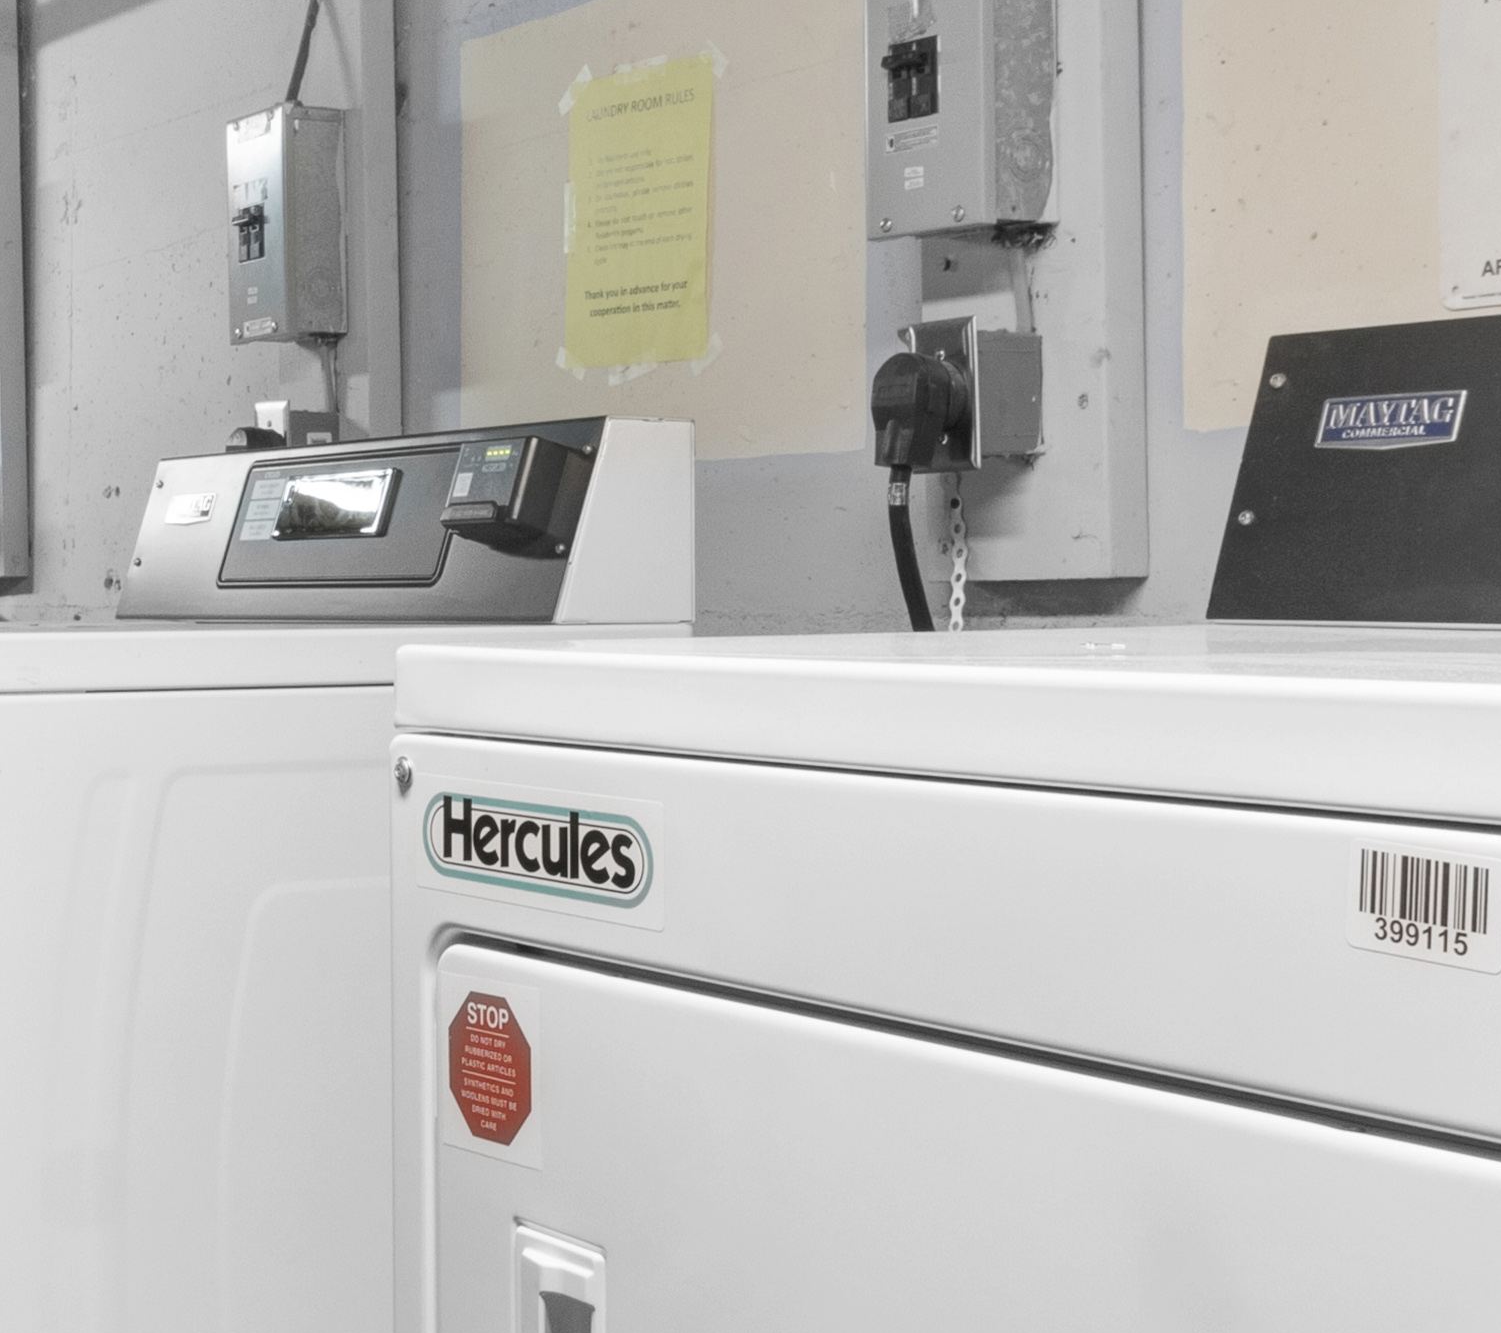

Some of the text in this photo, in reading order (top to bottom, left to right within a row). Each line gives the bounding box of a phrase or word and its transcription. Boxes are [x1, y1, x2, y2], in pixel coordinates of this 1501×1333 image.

[631, 95, 663, 112] ROOM
[665, 88, 695, 106] RULES
[584, 280, 688, 300] Thank you in advance for your
[589, 304, 631, 318] cooperation
[632, 302, 640, 312] in
[641, 300, 655, 312] this
[1325, 396, 1455, 430] MAYTAG
[1341, 425, 1427, 439] COMMERCIAL
[443, 794, 636, 890] Hercules
[1373, 916, 1469, 957] 399115
[467, 1001, 509, 1030] STOP
[470, 1033, 506, 1049] DO NOT DRY
[464, 1044, 513, 1063] RUBBERIZED OR
[461, 1056, 516, 1077] PLASTIC ARTICLES
[464, 1077, 514, 1097] SYNTHETICS AND
[461, 1089, 517, 1111] WOOLENS MUST BE
[471, 1104, 507, 1121] DRIED WITH
[480, 1119, 498, 1132] CARE
